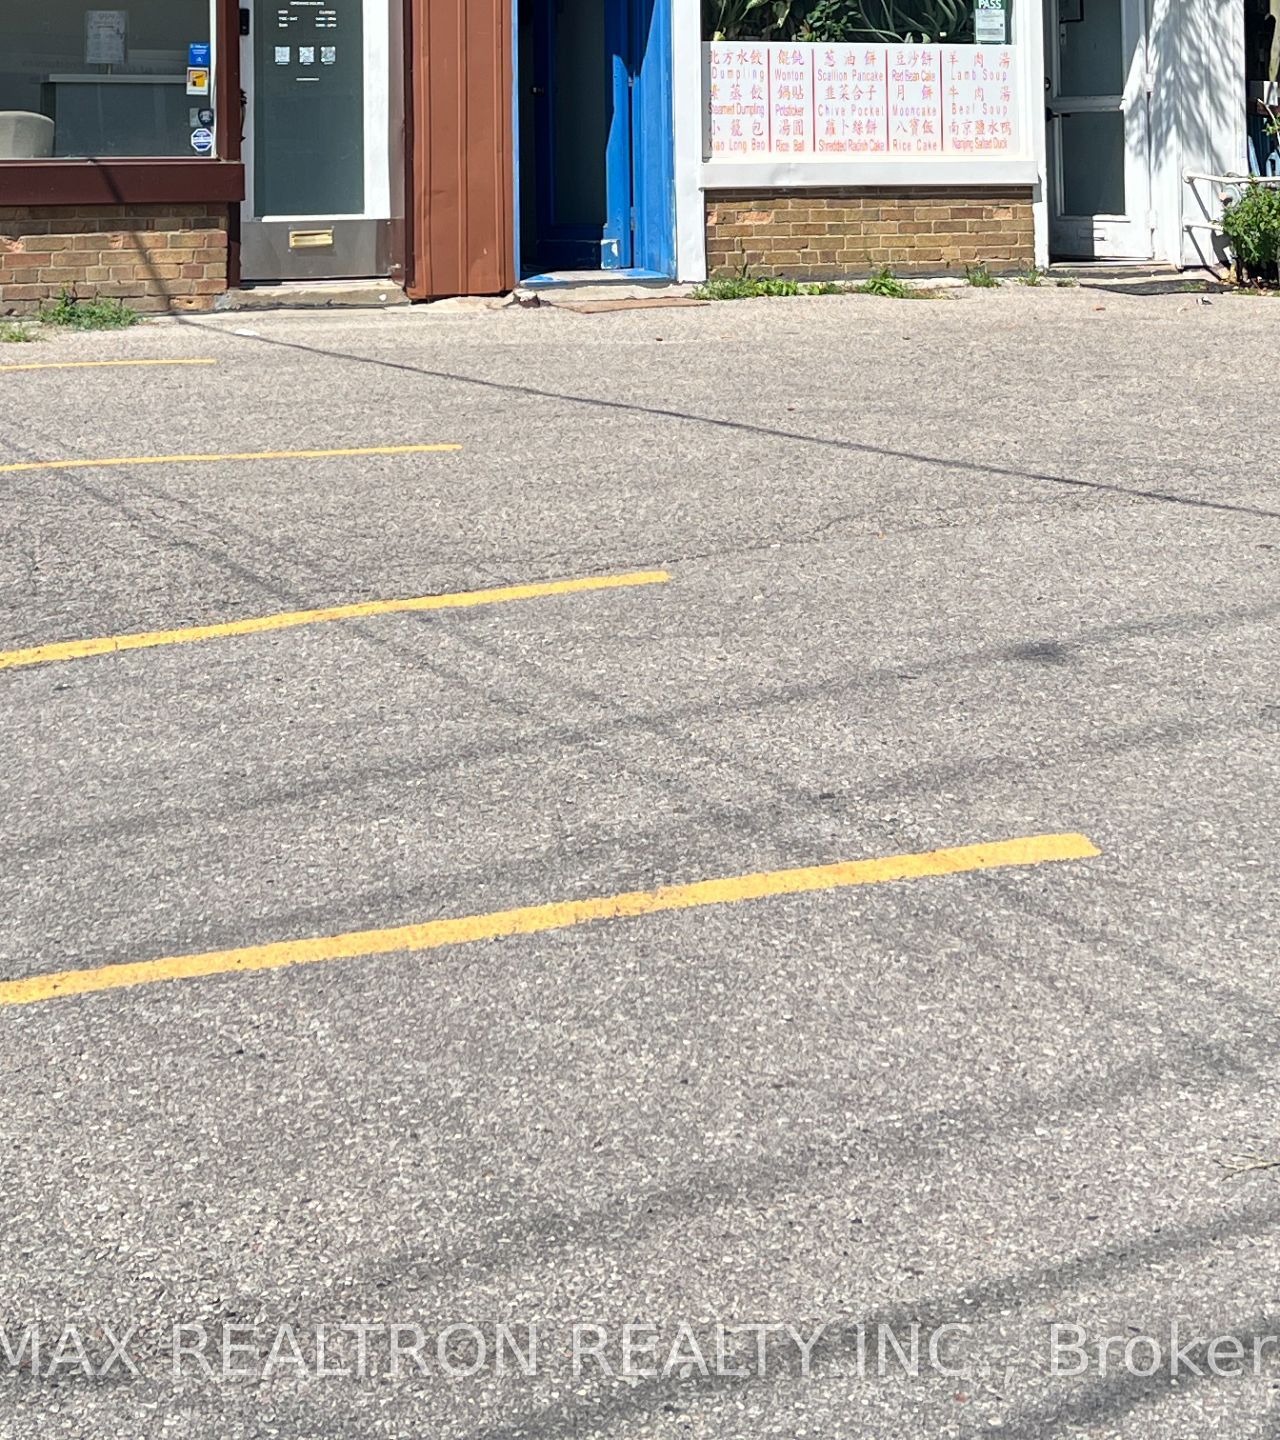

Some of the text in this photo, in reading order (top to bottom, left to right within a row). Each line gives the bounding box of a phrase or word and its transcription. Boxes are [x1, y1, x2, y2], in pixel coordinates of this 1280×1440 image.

[712, 66, 765, 81] Dumpling
[774, 67, 804, 81] Wonton
[817, 68, 884, 82] Scallion Pancake
[951, 68, 1008, 83] Lamb Soup
[817, 103, 846, 117] Chive
[892, 104, 937, 117] Mooncake
[982, 102, 1008, 117] Soup
[728, 138, 748, 154] Long
[751, 137, 766, 152] Bao
[892, 138, 937, 152] Rice Cake
